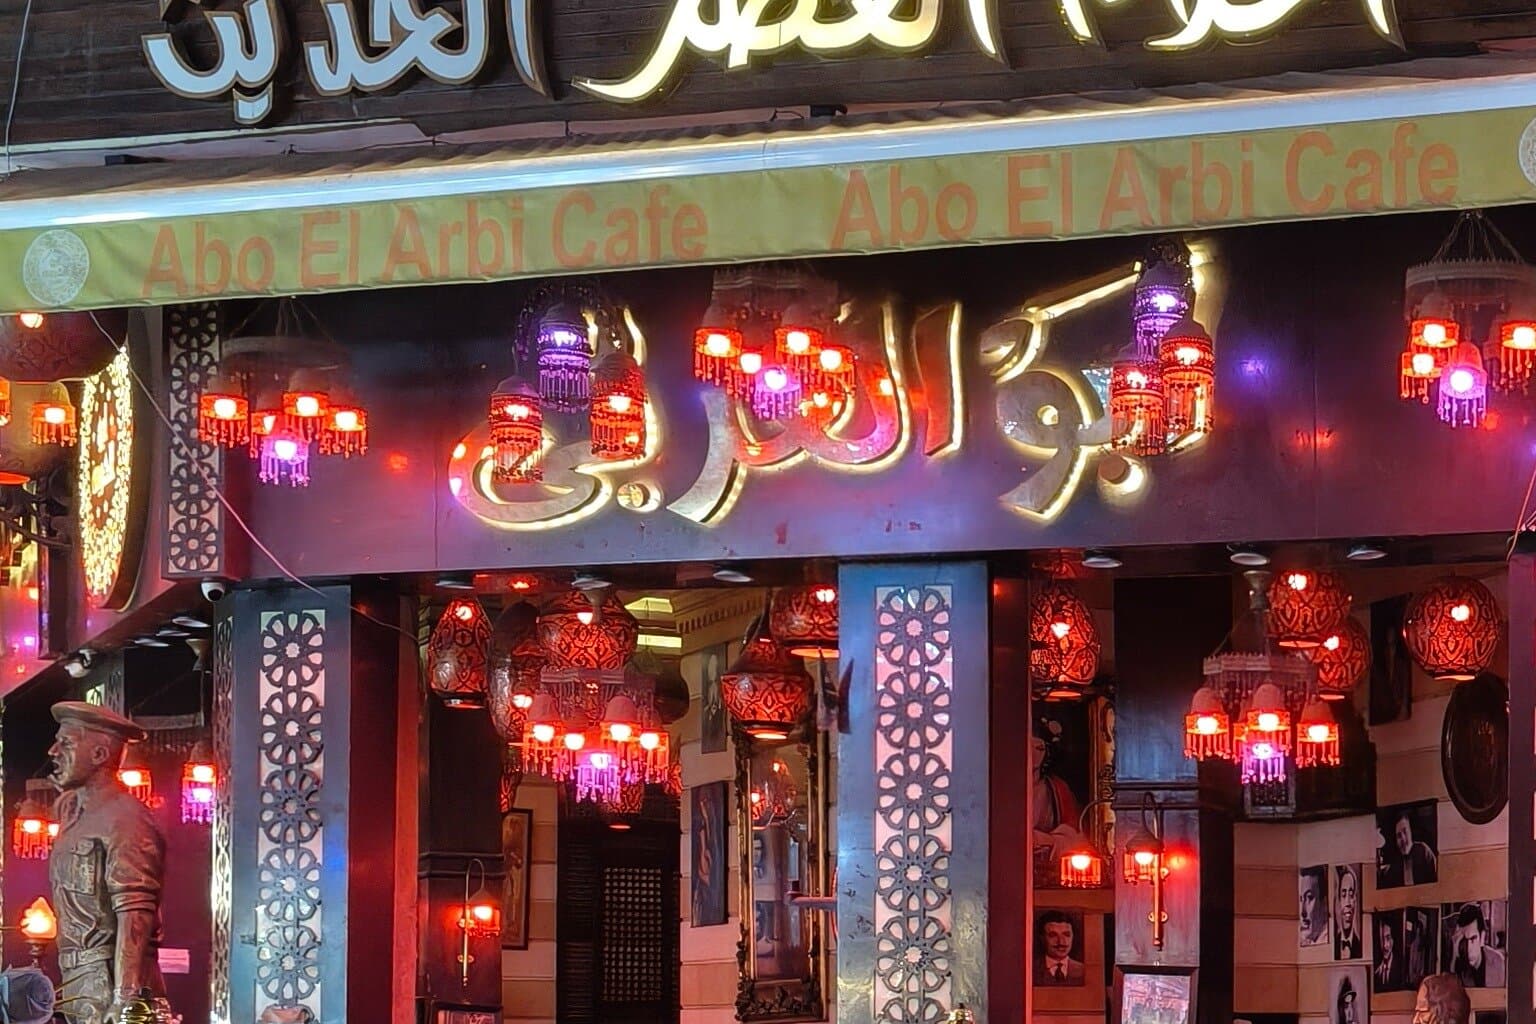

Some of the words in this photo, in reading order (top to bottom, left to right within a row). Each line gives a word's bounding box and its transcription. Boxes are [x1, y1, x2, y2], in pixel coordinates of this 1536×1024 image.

[141, 221, 275, 299] Abo
[302, 207, 361, 287] El
[381, 197, 525, 282] Arbi
[551, 182, 710, 269] Cafe
[829, 166, 979, 251] Abo
[1006, 151, 1073, 238] El
[1099, 138, 1255, 229] Arbi
[1284, 122, 1461, 214] Cafe
